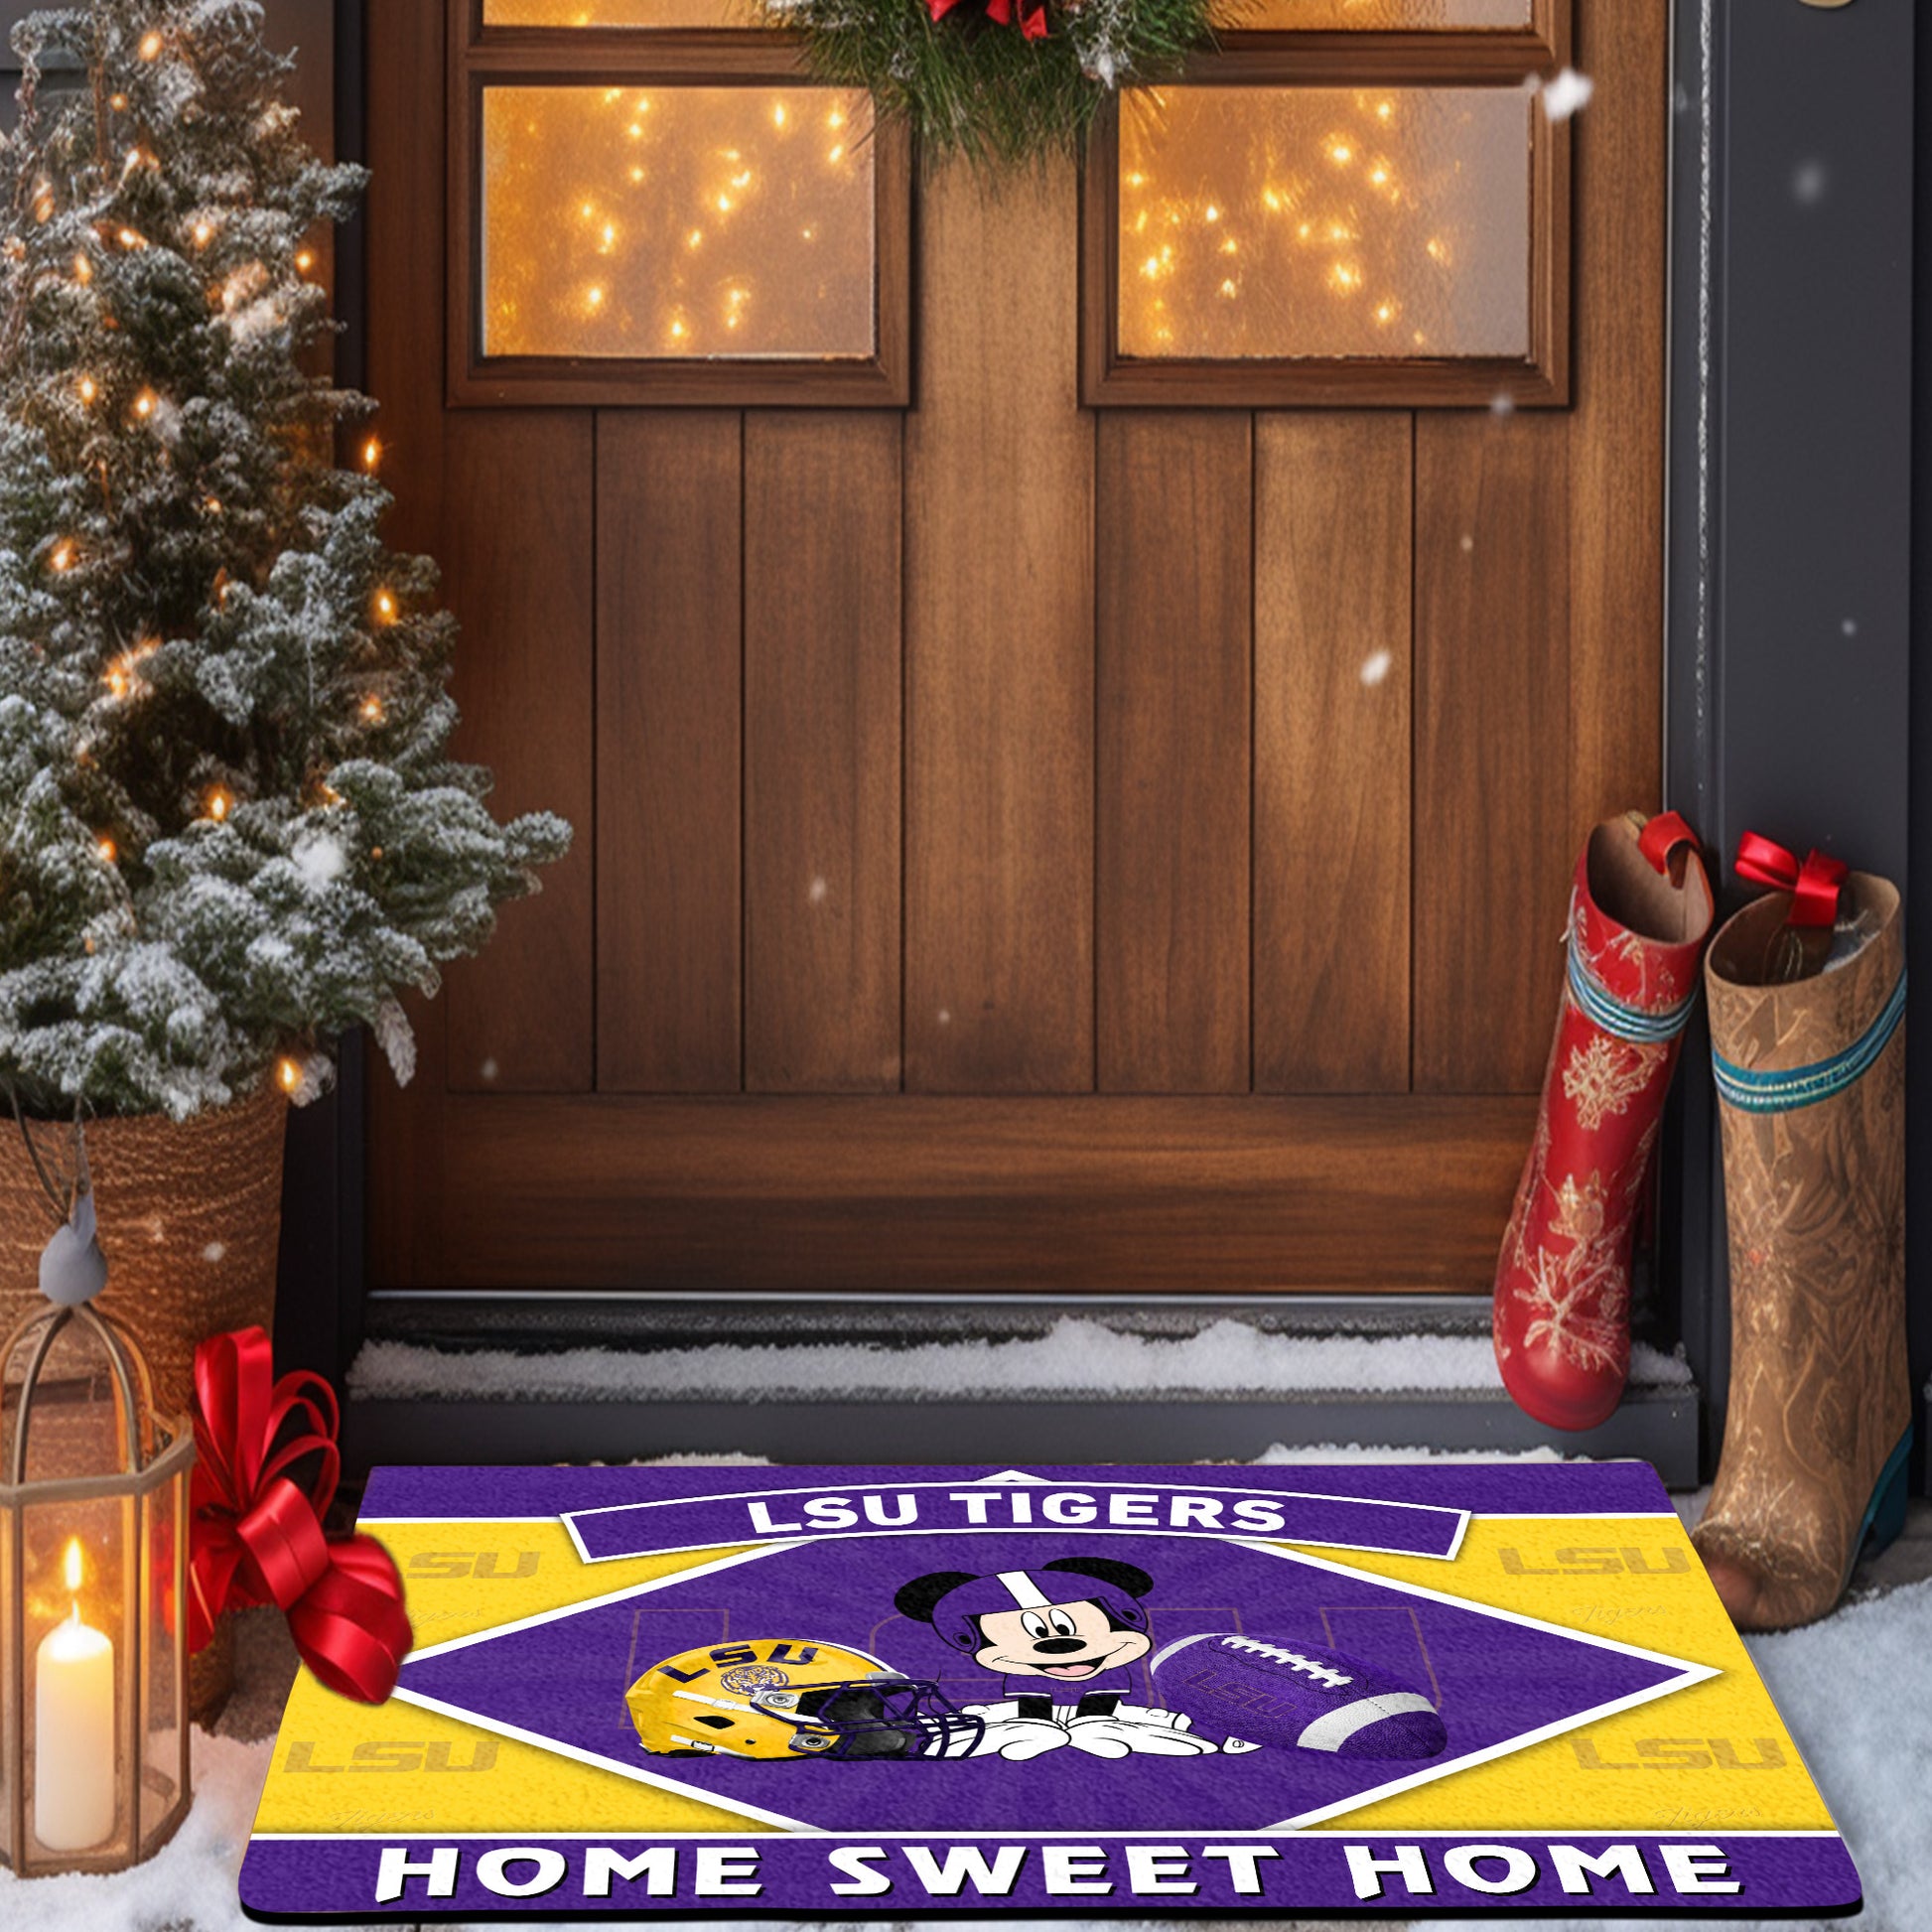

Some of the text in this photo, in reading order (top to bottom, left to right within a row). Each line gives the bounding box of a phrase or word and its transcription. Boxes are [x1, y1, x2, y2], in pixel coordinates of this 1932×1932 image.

[748, 1492, 1287, 1534] LSU TIGERS
[405, 1551, 540, 1580] SU
[1497, 1547, 1692, 1576] LSU
[657, 1643, 819, 1684] LSU
[1182, 1668, 1298, 1720] LSU
[283, 1740, 501, 1773] LSU
[1570, 1737, 1787, 1770] LSU
[375, 1844, 1744, 1905] HOME SWEET HOME
